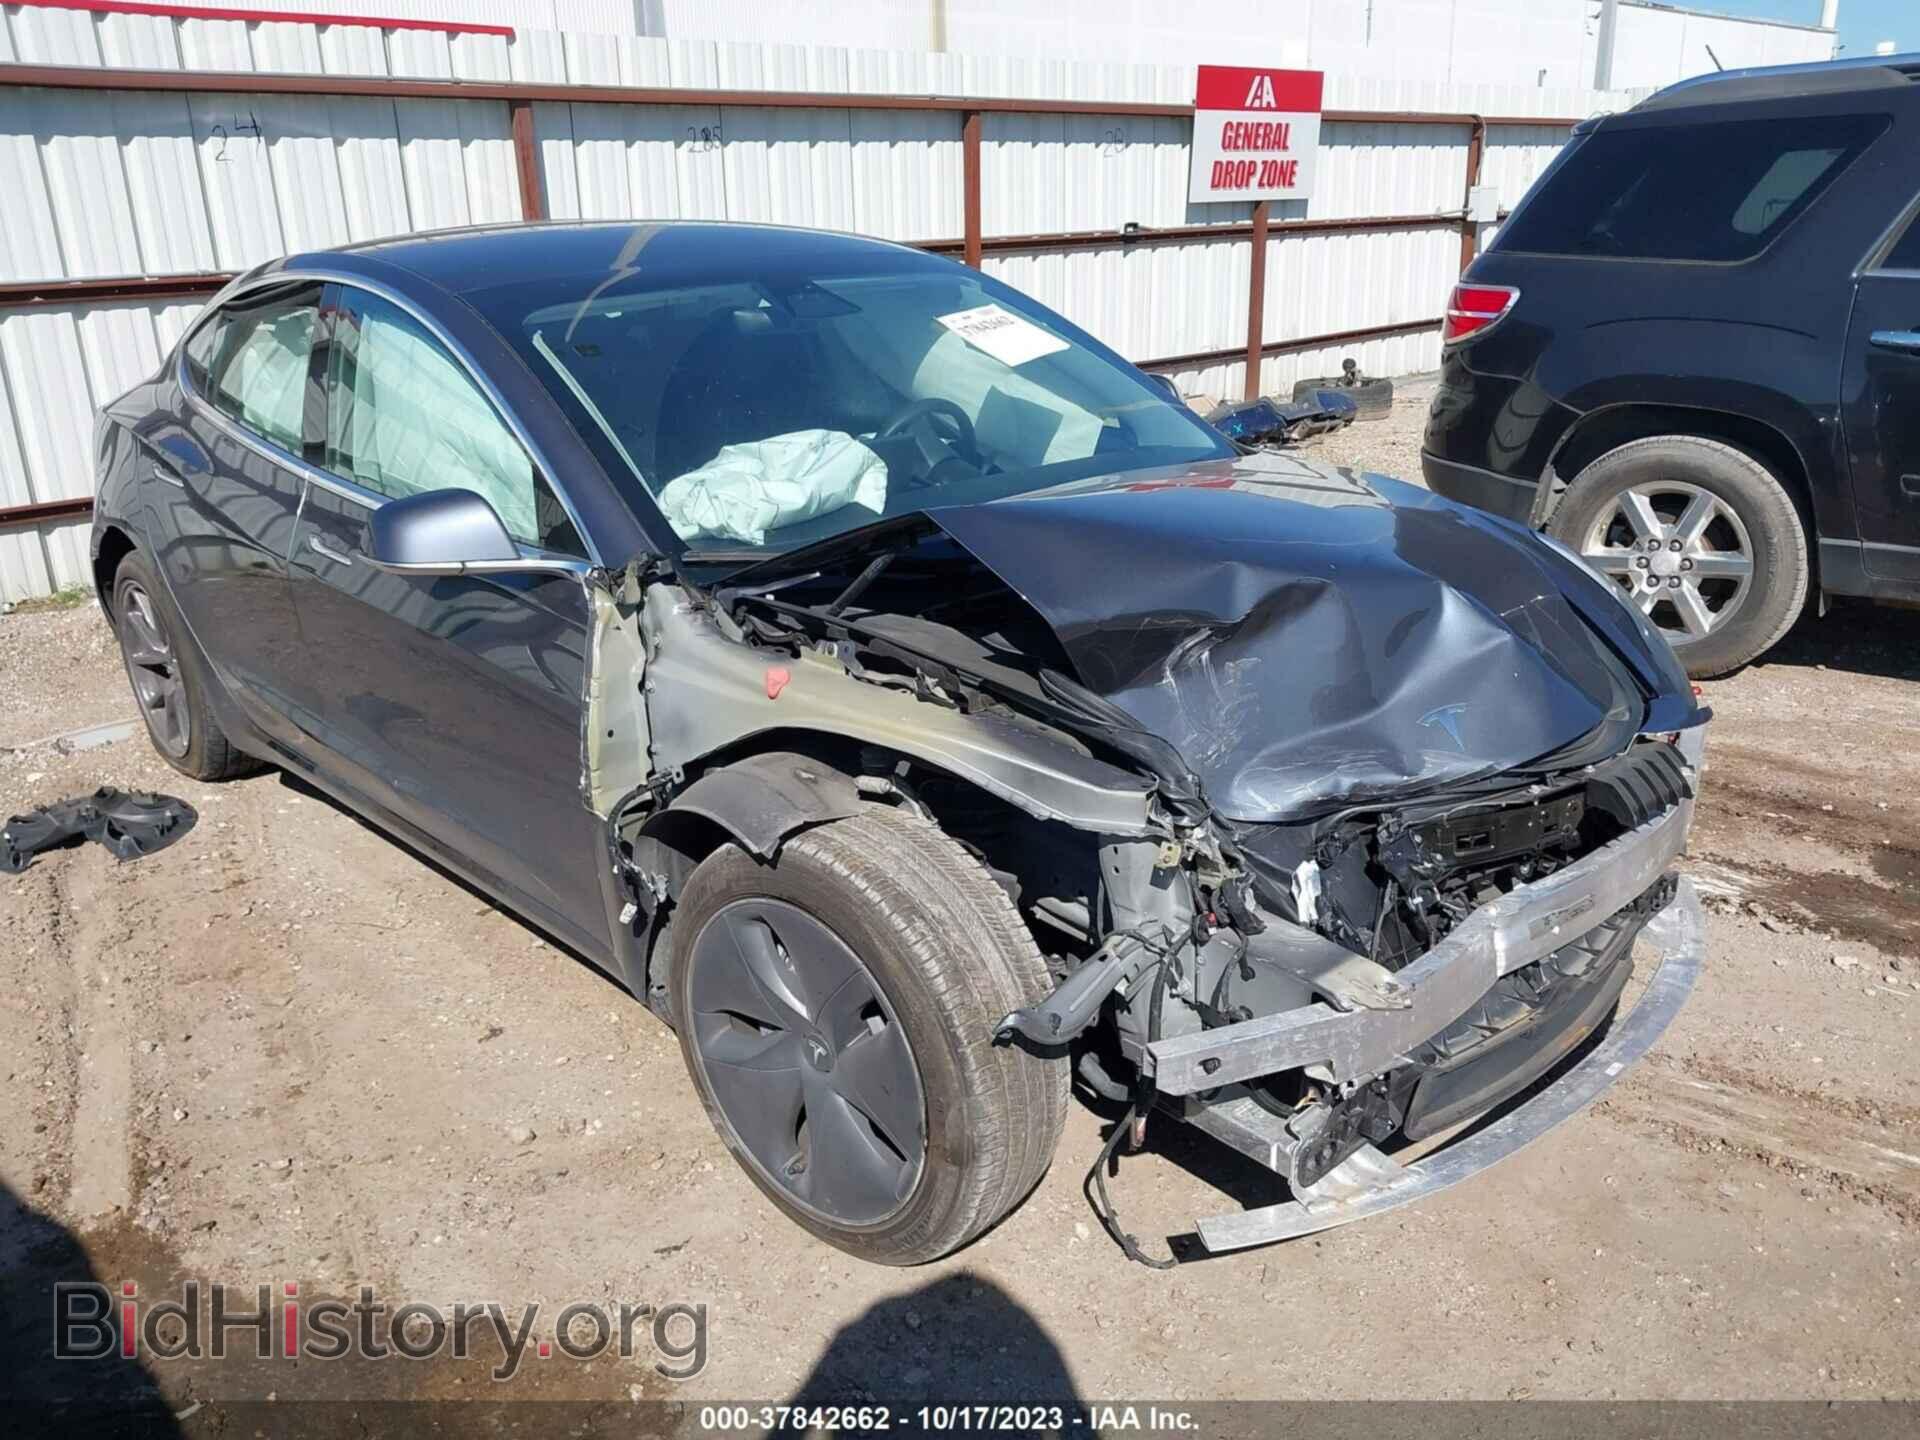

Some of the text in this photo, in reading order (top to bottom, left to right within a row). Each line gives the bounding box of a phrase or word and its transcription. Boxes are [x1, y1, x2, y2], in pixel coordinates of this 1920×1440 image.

[1221, 121, 1289, 151] GENERAL
[1210, 160, 1298, 190] DROP ZONE
